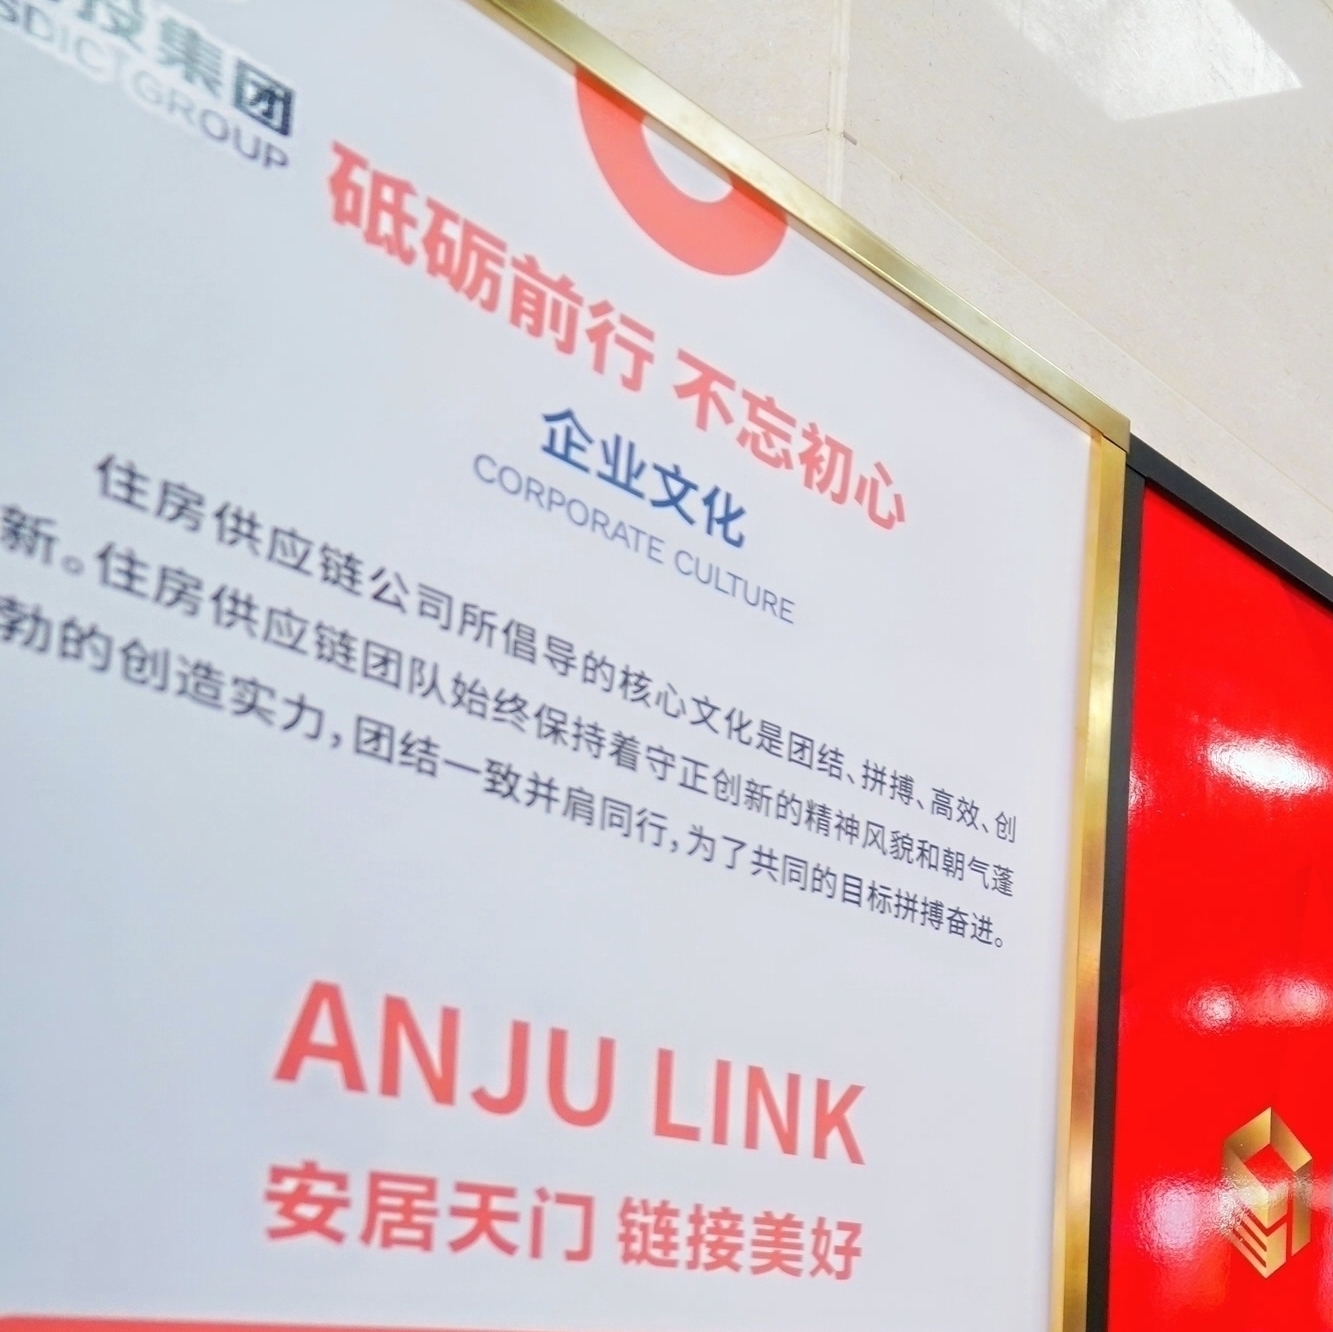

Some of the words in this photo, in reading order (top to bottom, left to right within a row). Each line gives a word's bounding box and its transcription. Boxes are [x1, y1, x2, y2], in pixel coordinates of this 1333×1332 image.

[132, 70, 290, 170] GROUP
[325, 140, 655, 394] 砥砺前行
[674, 347, 907, 531] 不忘初心
[473, 454, 664, 564] CORPORATE
[674, 548, 796, 625] CULTURE
[541, 408, 747, 547] 企业文化
[96, 452, 1017, 844] 住房供应链公司所倡导的核心文化是团结、拼搏、高效、创
[273, 978, 616, 1128] ANJU
[653, 1047, 867, 1165] LINK
[264, 1159, 595, 1262] 安居天门
[617, 1196, 862, 1280] 链接美好
